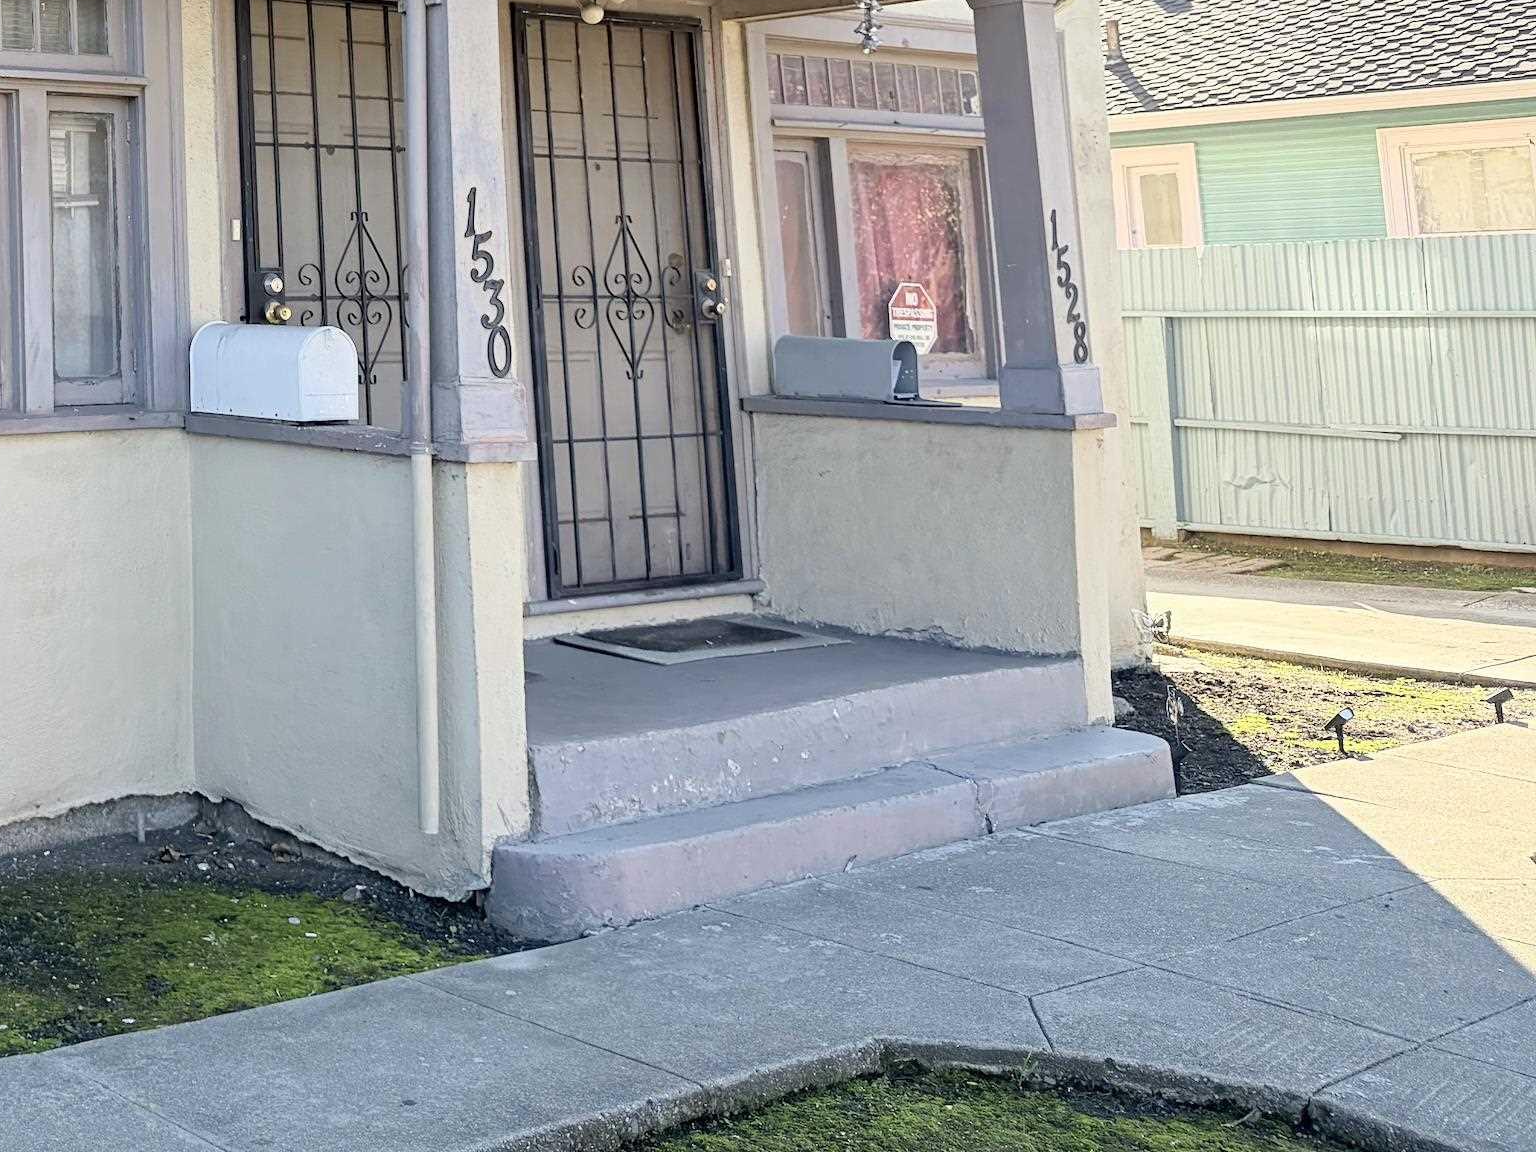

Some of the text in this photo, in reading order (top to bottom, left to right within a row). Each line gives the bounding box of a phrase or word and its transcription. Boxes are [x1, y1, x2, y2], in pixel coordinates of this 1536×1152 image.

[464, 186, 512, 378] 1530
[905, 291, 919, 307] NO
[1050, 209, 1088, 364] 1528
